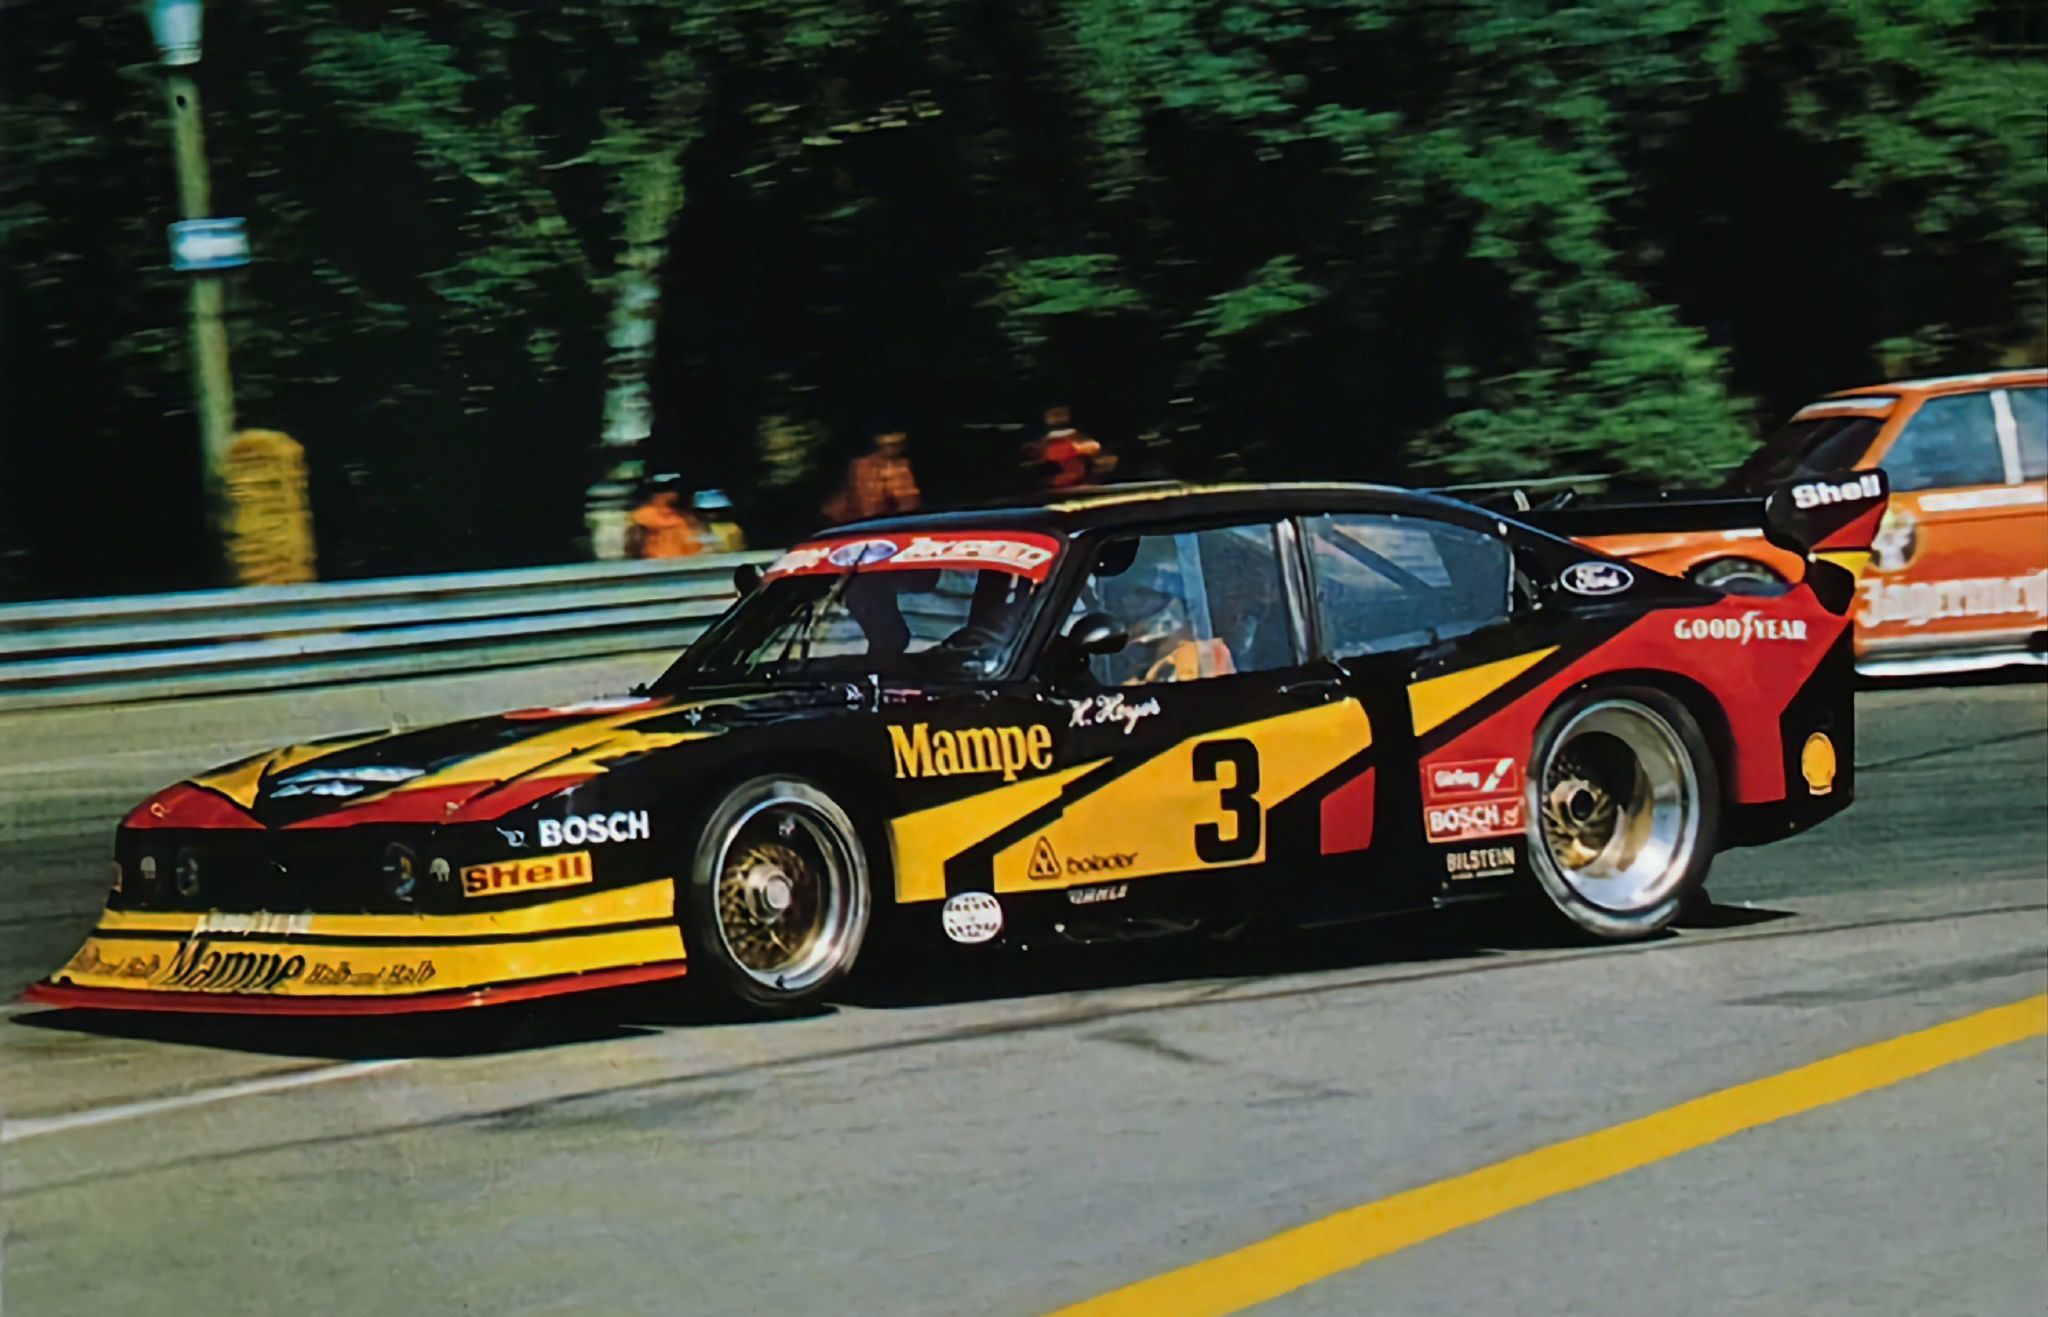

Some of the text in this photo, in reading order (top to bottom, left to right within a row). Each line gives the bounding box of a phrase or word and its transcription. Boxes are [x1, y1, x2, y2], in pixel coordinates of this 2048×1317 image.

[1792, 474, 1881, 509] Shell
[1674, 610, 1807, 645] GOODYEAR
[887, 722, 1053, 782] Mampe
[1191, 738, 1261, 864] 3
[1429, 803, 1500, 833] BOSCH
[538, 809, 650, 848] BOSCH
[465, 855, 585, 893] Shell
[1446, 847, 1515, 873] BILSTEIN
[153, 938, 306, 993] Mampe
